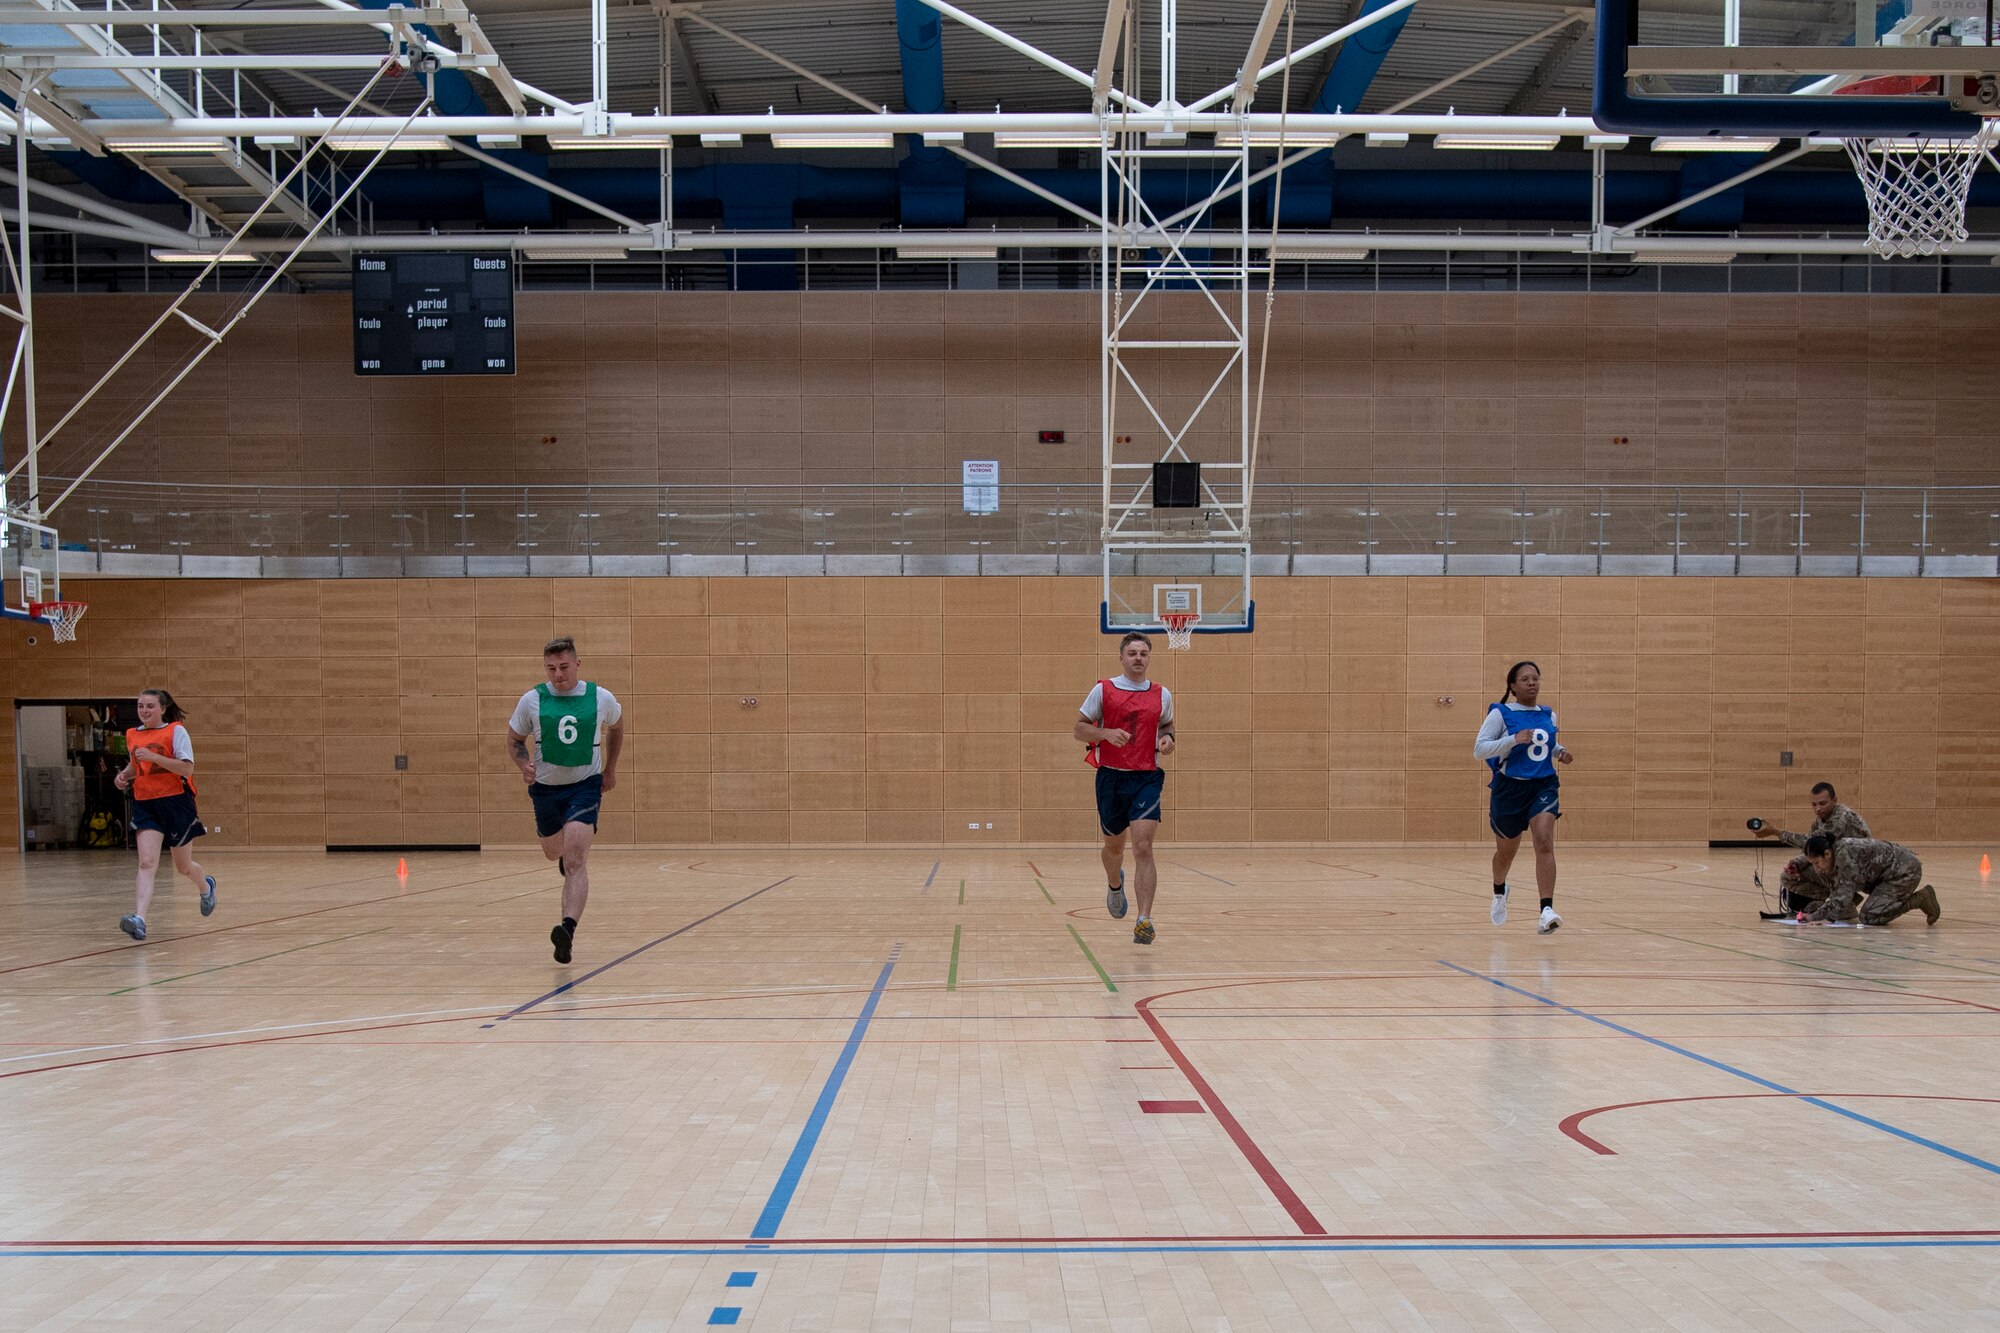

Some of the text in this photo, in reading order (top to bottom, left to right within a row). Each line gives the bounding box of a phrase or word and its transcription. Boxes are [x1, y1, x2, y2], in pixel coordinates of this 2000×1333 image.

[360, 259, 386, 271] Home
[473, 258, 506, 270] Guests
[417, 298, 447, 311] period
[359, 317, 381, 329] fouls
[417, 316, 448, 330] player
[484, 317, 506, 328] fouls
[362, 359, 380, 369] won
[422, 359, 445, 371] game
[487, 358, 505, 368] won
[558, 715, 578, 744] 6
[1122, 711, 1138, 744] 1
[1527, 728, 1549, 762] 8
